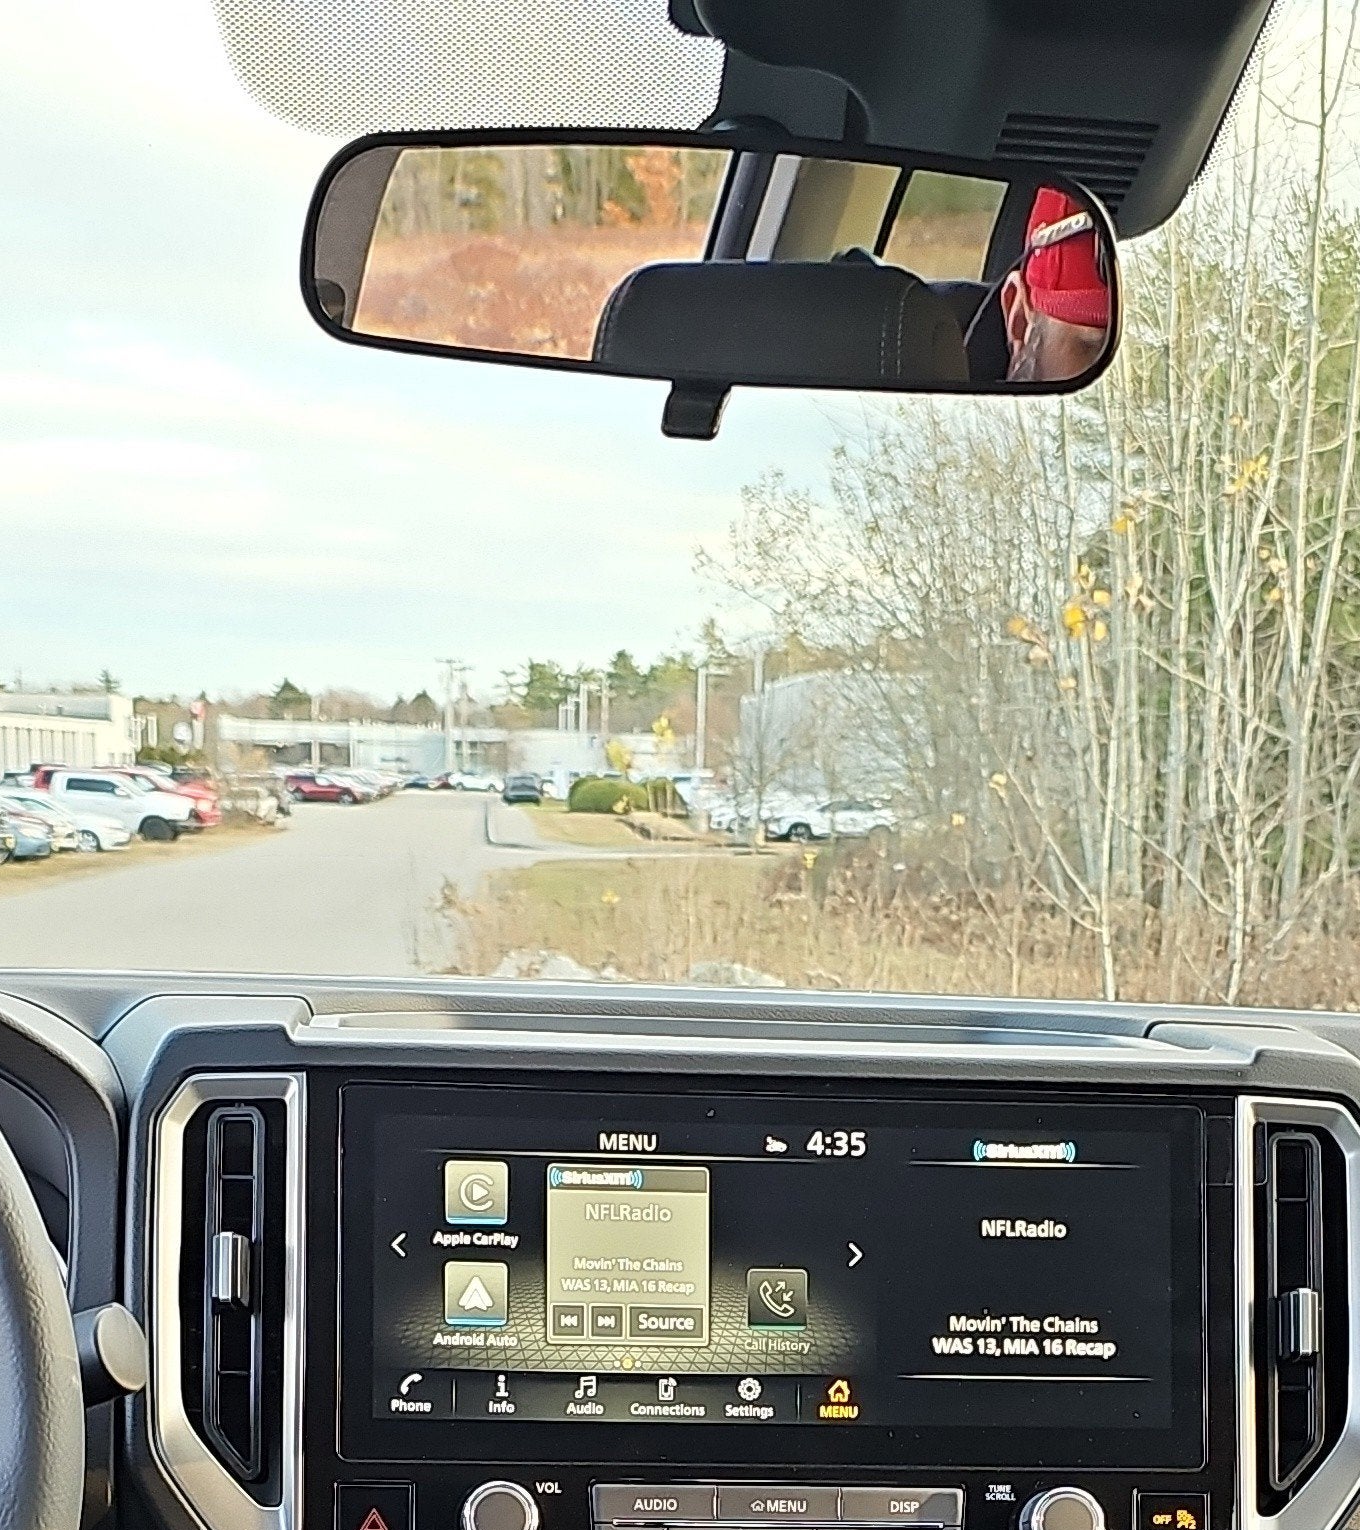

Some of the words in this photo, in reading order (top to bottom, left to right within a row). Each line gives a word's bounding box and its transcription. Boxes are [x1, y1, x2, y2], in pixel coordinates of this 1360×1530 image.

[599, 1133, 658, 1152] MENU
[806, 1130, 867, 1157] 4:35
[585, 1203, 672, 1223] NFLRadio
[981, 1220, 1067, 1239] NFLRadio
[432, 1231, 471, 1247] Apple
[472, 1231, 519, 1249] CarPlay
[573, 1257, 617, 1272] Movin'
[619, 1257, 641, 1272] The
[642, 1258, 683, 1273] Chains
[561, 1278, 591, 1293] WAS
[593, 1279, 611, 1295] 13,
[613, 1279, 639, 1294] MIA
[642, 1279, 656, 1294] 16
[657, 1280, 695, 1296] Recap
[638, 1314, 694, 1331] Source
[949, 1316, 1006, 1334] Movin'
[1009, 1316, 1041, 1334] The
[1043, 1317, 1098, 1334] Chains
[433, 1332, 484, 1347] Android
[486, 1332, 518, 1347] Auto
[744, 1339, 766, 1351] Call
[768, 1339, 811, 1354] History
[932, 1338, 974, 1355] WAS
[977, 1339, 1001, 1357] 13,
[1004, 1339, 1039, 1356] MIA
[1044, 1340, 1063, 1356] 16
[1065, 1340, 1116, 1359] Recap
[390, 1398, 432, 1412] Phone
[488, 1401, 515, 1414] Info
[566, 1402, 604, 1416] Audio
[630, 1402, 706, 1417] Connections
[725, 1403, 774, 1419] Settings
[819, 1404, 858, 1419] MENU
[536, 1481, 562, 1495] VOL
[988, 1485, 1012, 1493] TUNE
[985, 1492, 1016, 1501] SCROLL
[633, 1498, 678, 1512] AUDIO
[766, 1499, 807, 1514] MENU
[890, 1500, 920, 1515] DISP
[1152, 1514, 1172, 1525] OFF
